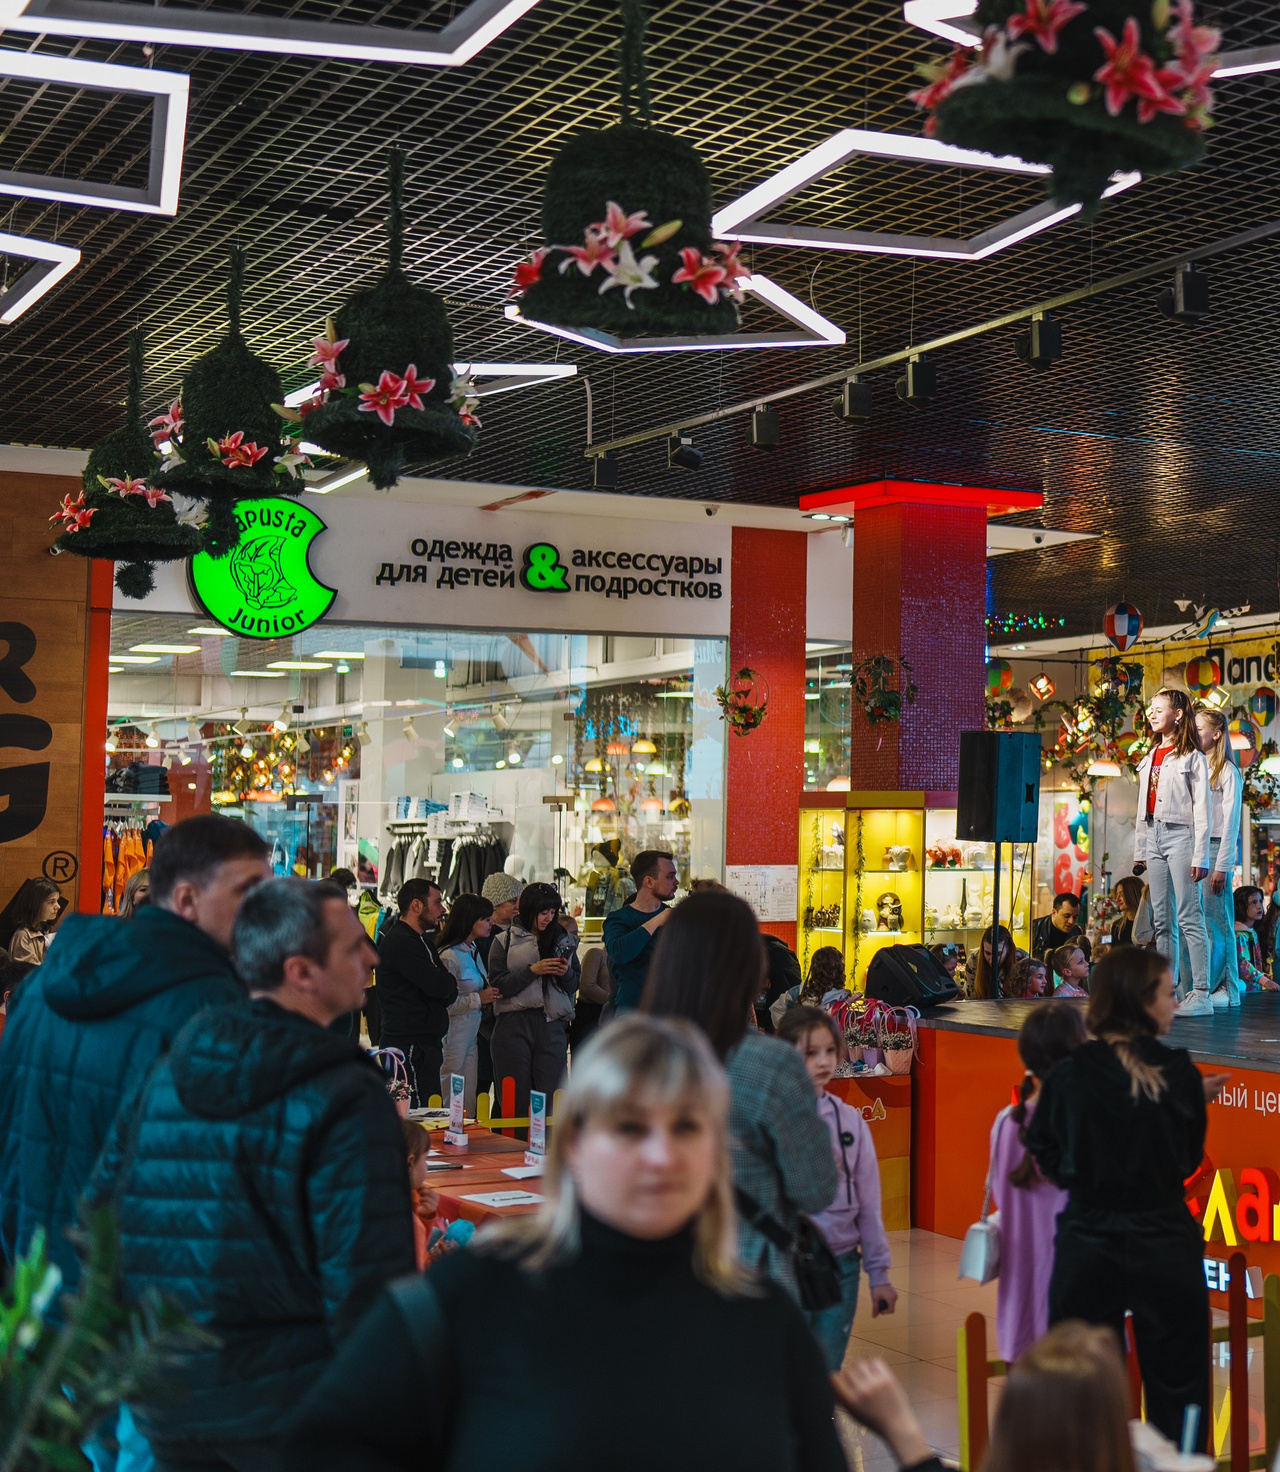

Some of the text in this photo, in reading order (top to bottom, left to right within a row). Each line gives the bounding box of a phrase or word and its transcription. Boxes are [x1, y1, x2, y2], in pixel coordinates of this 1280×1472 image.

[237, 508, 307, 538] apusta
[410, 538, 513, 566] одежда
[571, 548, 723, 578] аксессуары
[375, 562, 516, 590] для детей
[519, 542, 572, 593] &
[574, 572, 723, 600] подростков
[228, 607, 305, 634] Junior
